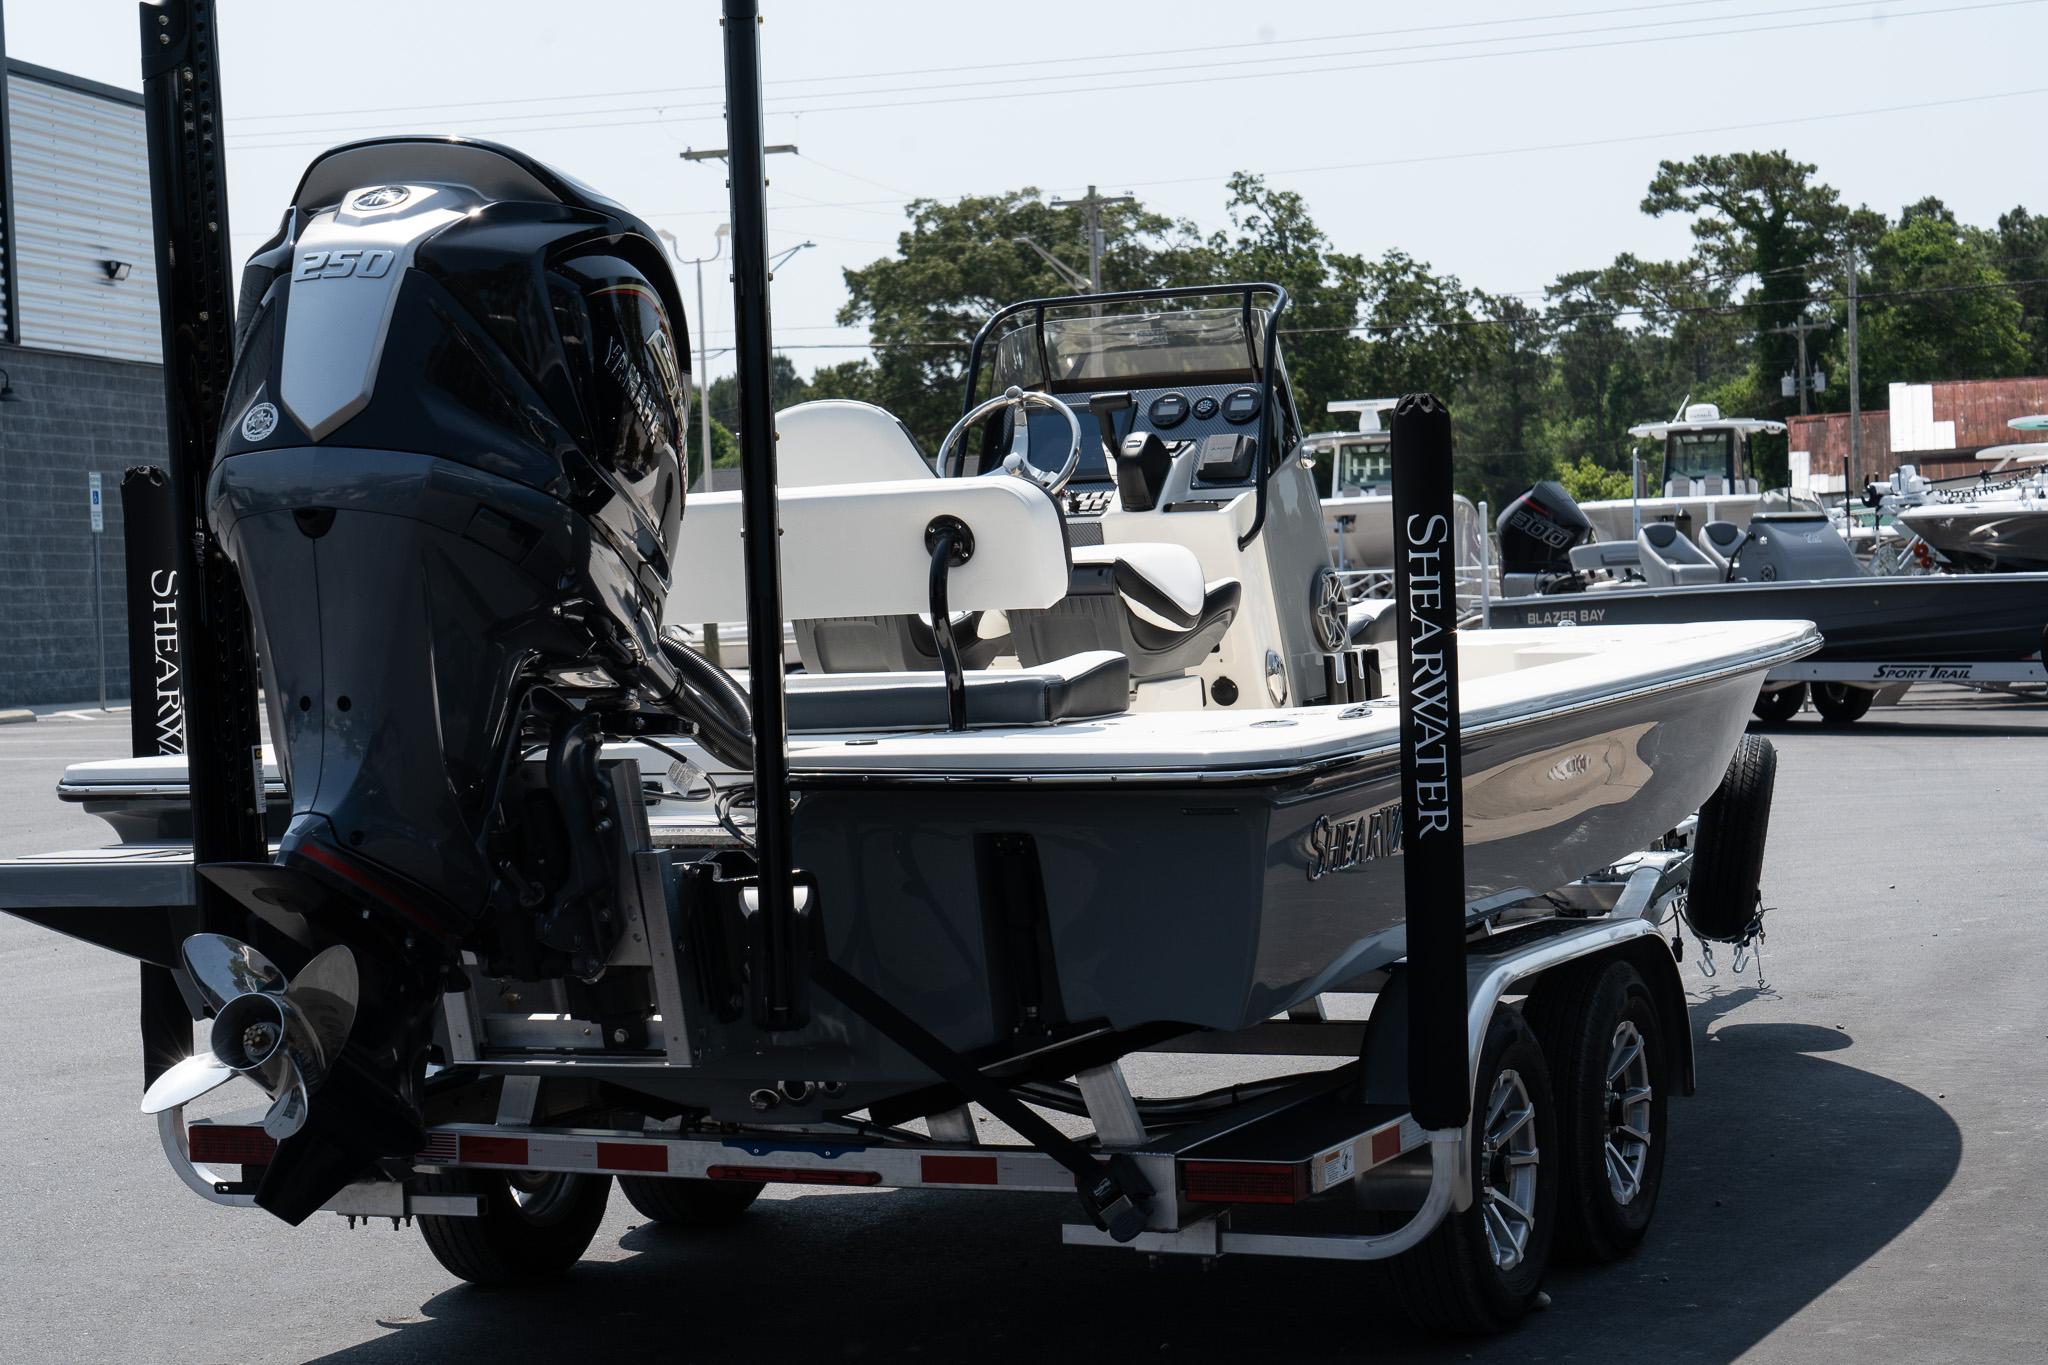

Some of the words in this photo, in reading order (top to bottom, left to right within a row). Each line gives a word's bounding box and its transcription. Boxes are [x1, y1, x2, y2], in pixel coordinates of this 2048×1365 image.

[294, 249, 395, 282] 250
[1527, 610, 1577, 625] BLAZER
[1580, 609, 1606, 622] BAY
[151, 569, 184, 755] SHEARW
[1407, 514, 1450, 840] SHEARWATER
[1873, 664, 1929, 679] SPORT
[1929, 664, 1973, 679] TRAIL
[1306, 802, 1403, 881] SHEARW
